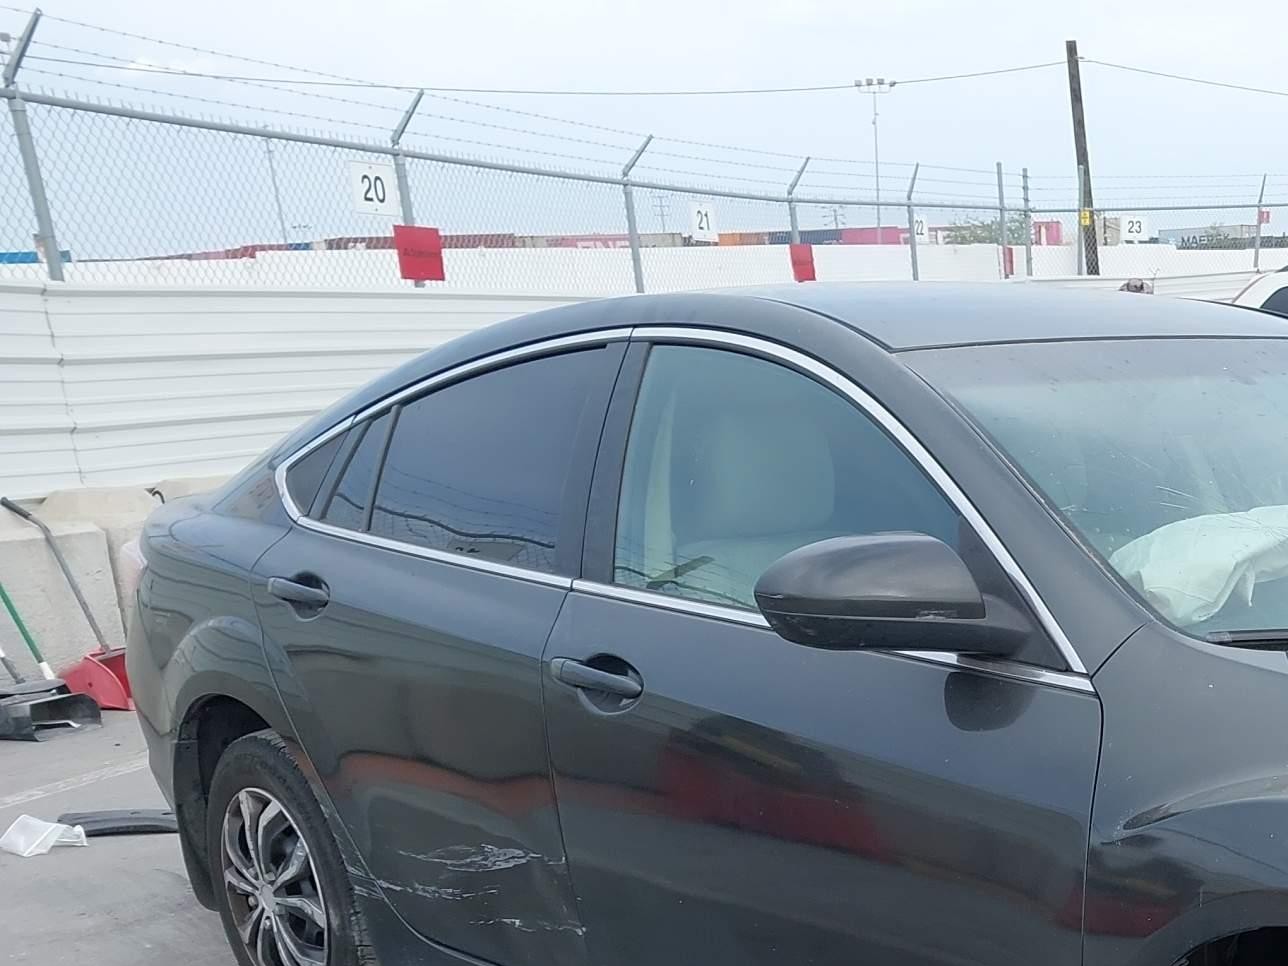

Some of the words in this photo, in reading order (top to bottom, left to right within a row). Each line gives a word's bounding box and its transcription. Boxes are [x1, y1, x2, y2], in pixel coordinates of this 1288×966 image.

[361, 174, 386, 203] 20
[696, 210, 710, 231] 21
[914, 219, 925, 236] 22
[1127, 220, 1142, 234] 23
